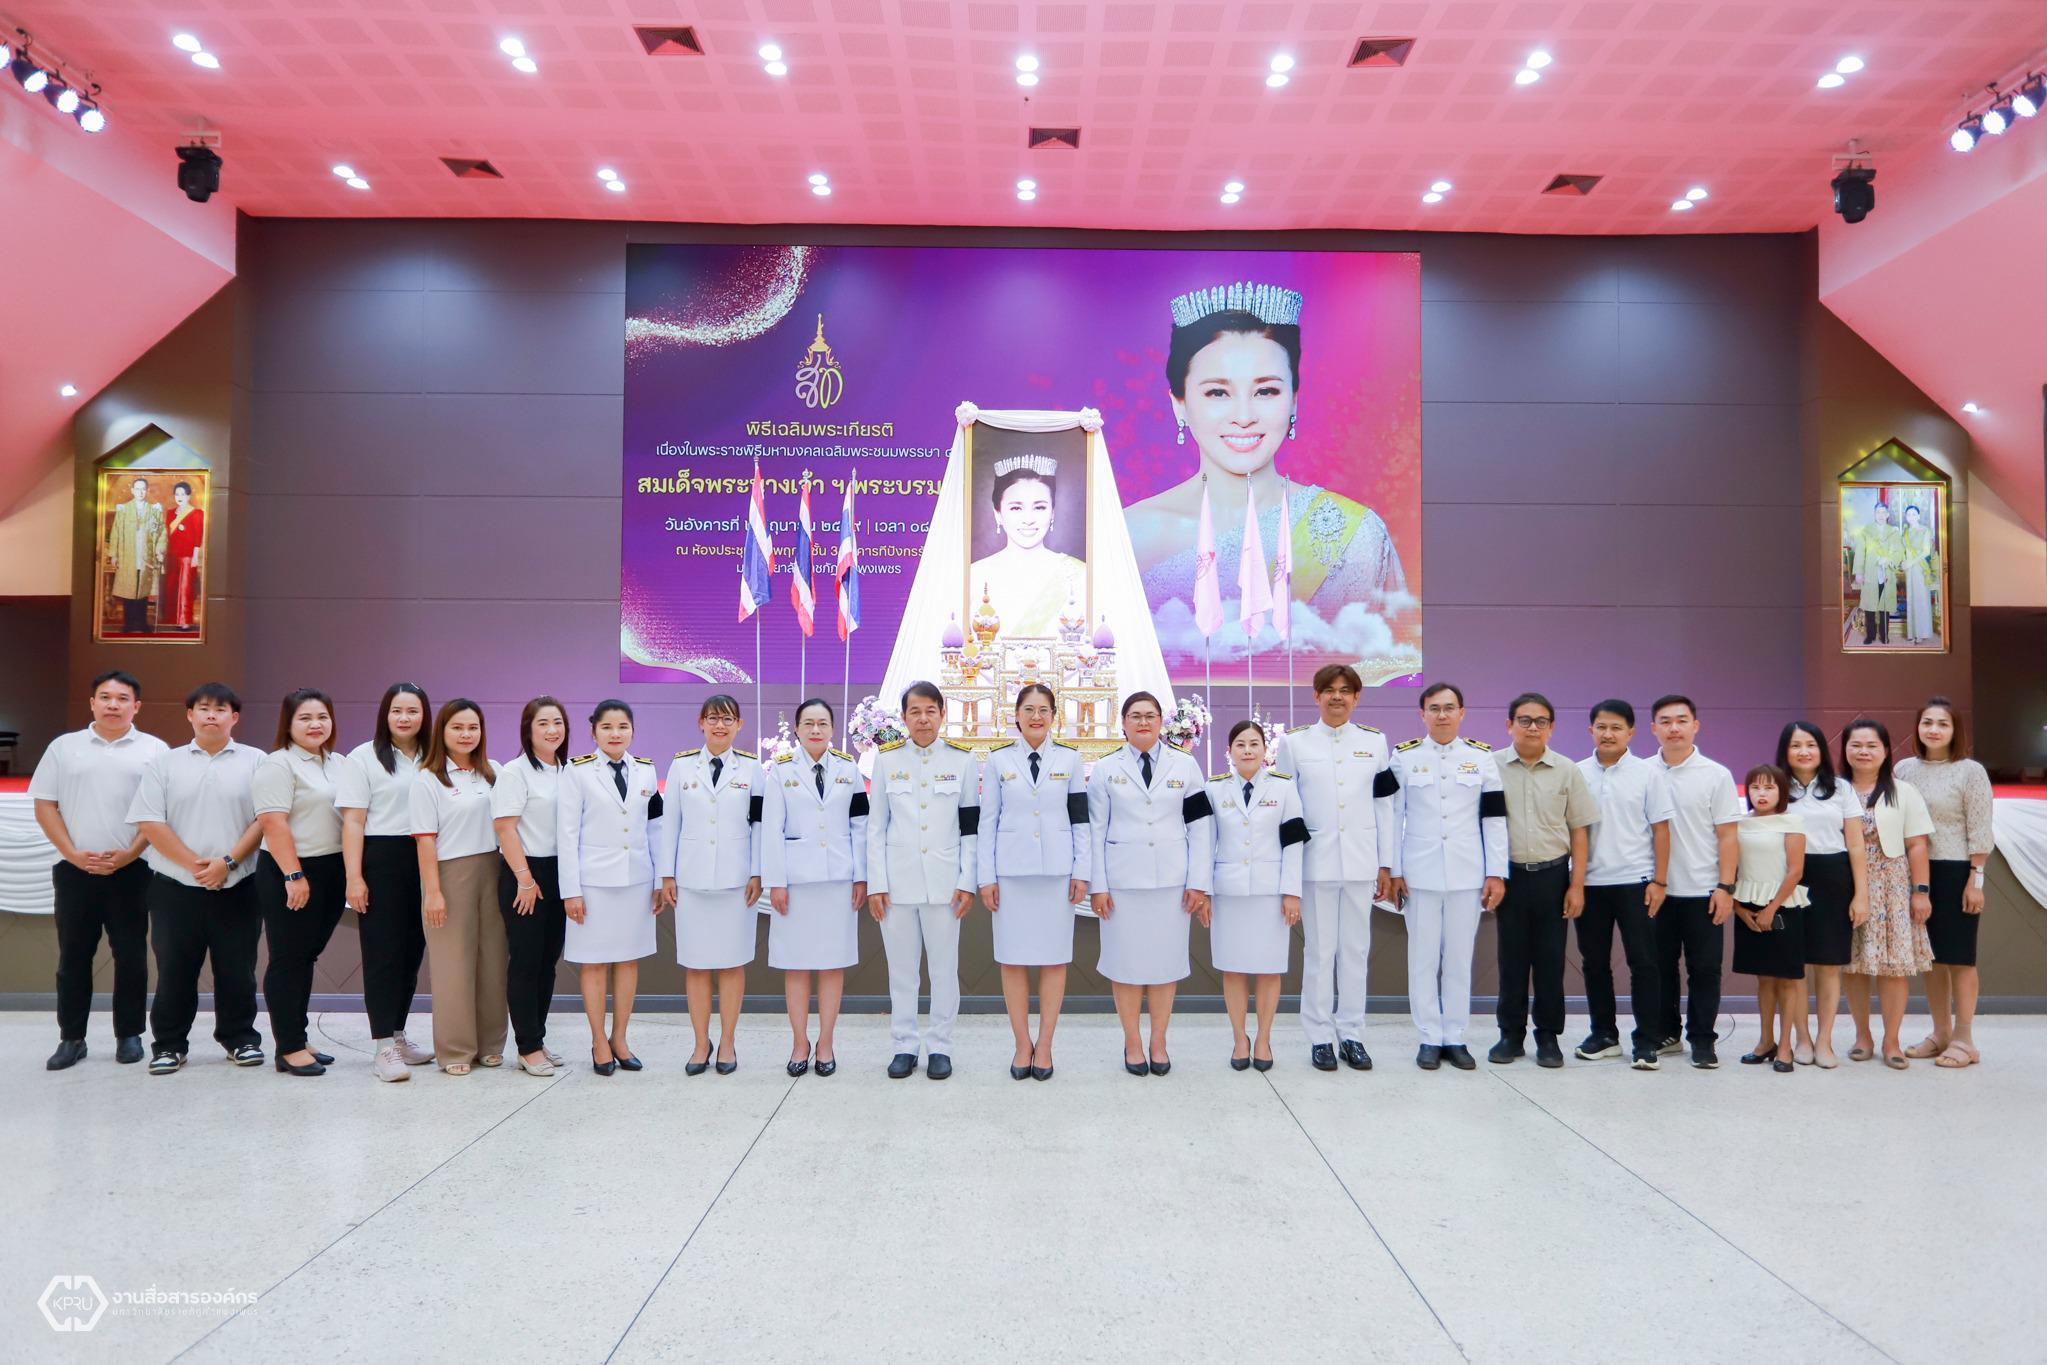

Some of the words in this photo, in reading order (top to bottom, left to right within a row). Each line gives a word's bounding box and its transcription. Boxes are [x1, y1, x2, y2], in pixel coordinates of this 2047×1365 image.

[746, 420, 894, 437] พิธีเฉลิมพระเกียรติ
[656, 440, 940, 458] เนื่องในพระราชพิธีมหามงคลเฉลิมพระชนมพรรษา
[664, 515, 740, 531] วันอังคารที่
[875, 521, 905, 533] เวลา
[676, 546, 688, 556] ณ
[831, 546, 838, 556] 3
